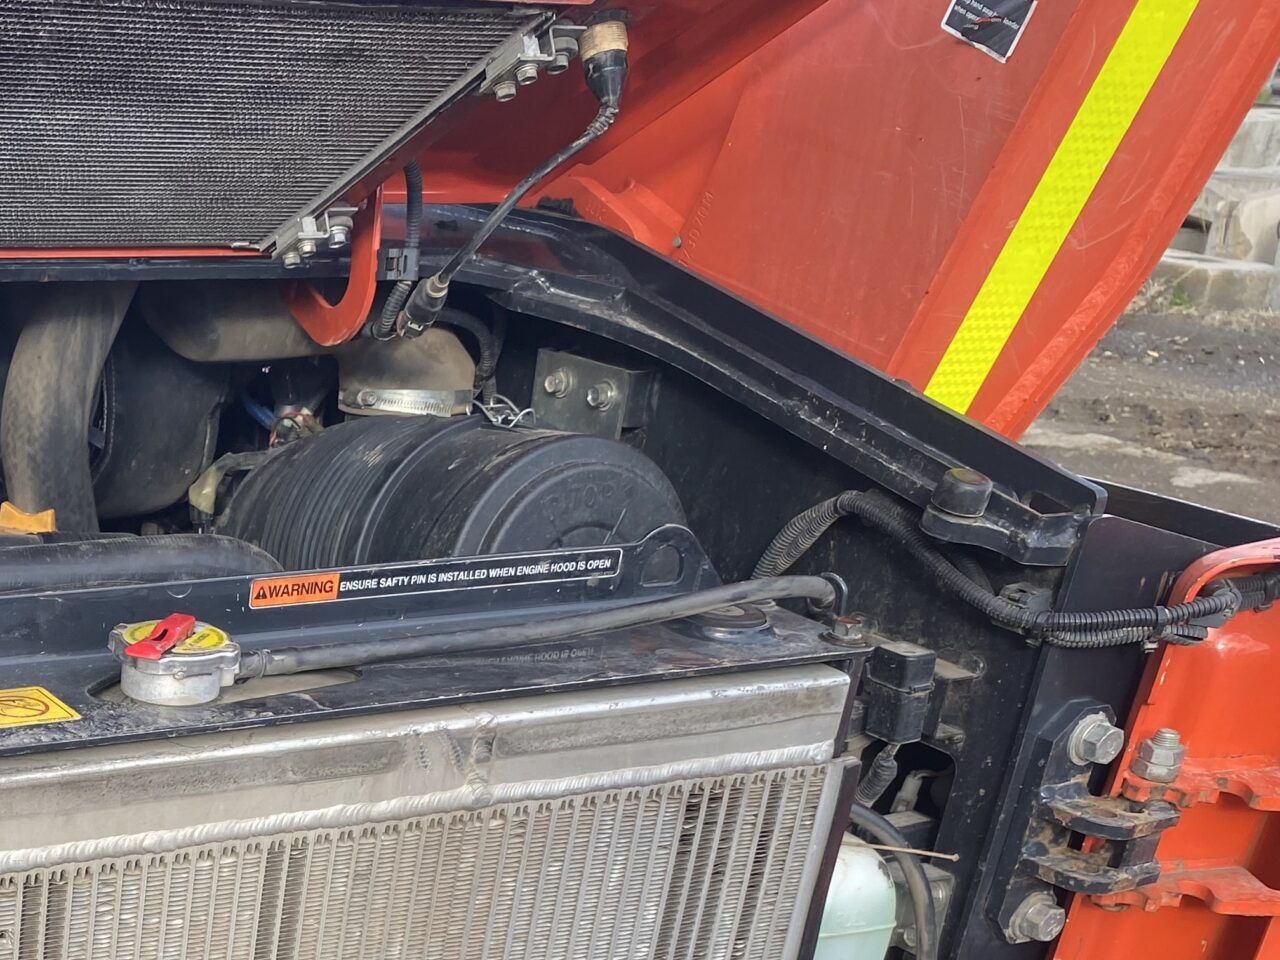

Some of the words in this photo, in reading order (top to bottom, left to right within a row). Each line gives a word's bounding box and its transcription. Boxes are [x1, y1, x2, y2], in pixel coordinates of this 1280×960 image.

[269, 580, 334, 599] WARNING
[340, 578, 378, 592] ENSURE
[379, 575, 410, 588] SAFTY
[411, 574, 427, 585] PIN
[428, 573, 437, 583] IS
[438, 569, 488, 582] INSTALLED
[489, 566, 515, 578] WHEN
[516, 563, 550, 576] ENGINE
[551, 562, 576, 573] HOOD
[577, 561, 586, 571] IS
[587, 558, 612, 570] OPEN
